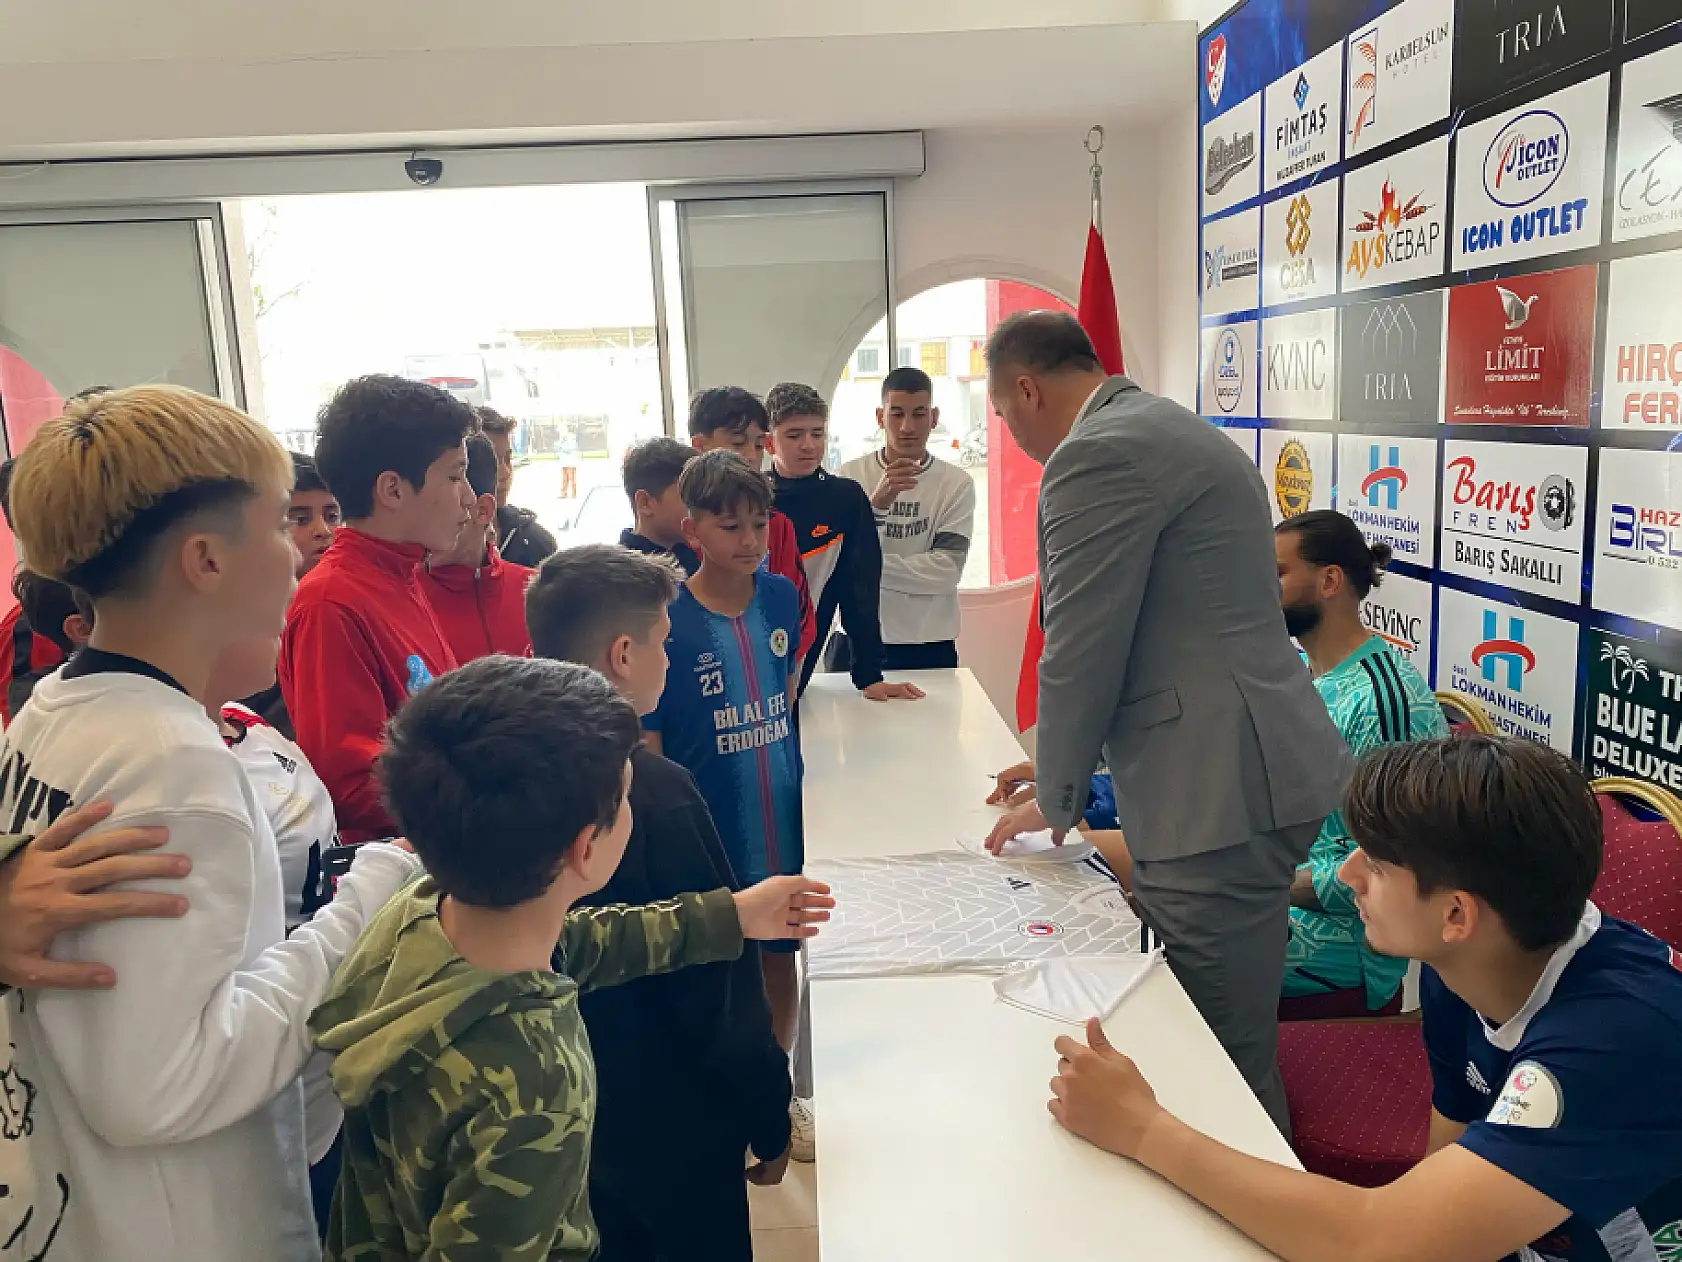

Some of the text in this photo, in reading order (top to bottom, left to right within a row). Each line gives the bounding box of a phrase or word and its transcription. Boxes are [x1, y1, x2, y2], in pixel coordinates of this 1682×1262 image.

[1277, 103, 1328, 151] FİMTAŞ
[1517, 157, 1558, 180] OUTLET
[1462, 198, 1588, 254] ICON OUTLET
[1267, 339, 1326, 391] KVNC
[1485, 342, 1545, 371] LİMİT
[1363, 373, 1412, 400] TRIA
[1623, 392, 1682, 424] FER
[1447, 456, 1536, 531] Barış
[1388, 514, 1420, 534] HEKİM
[1454, 511, 1517, 534] FREN
[1500, 549, 1562, 586] SAKALLI
[1364, 601, 1421, 651] SEVİNÇ
[700, 671, 724, 697] 23
[1659, 669, 1682, 701] TH
[714, 701, 765, 731] BİLAL
[1452, 675, 1552, 730] LOKMAN HEKİM
[1597, 692, 1682, 754] BLUE LA
[1592, 734, 1682, 789] DELUXE
